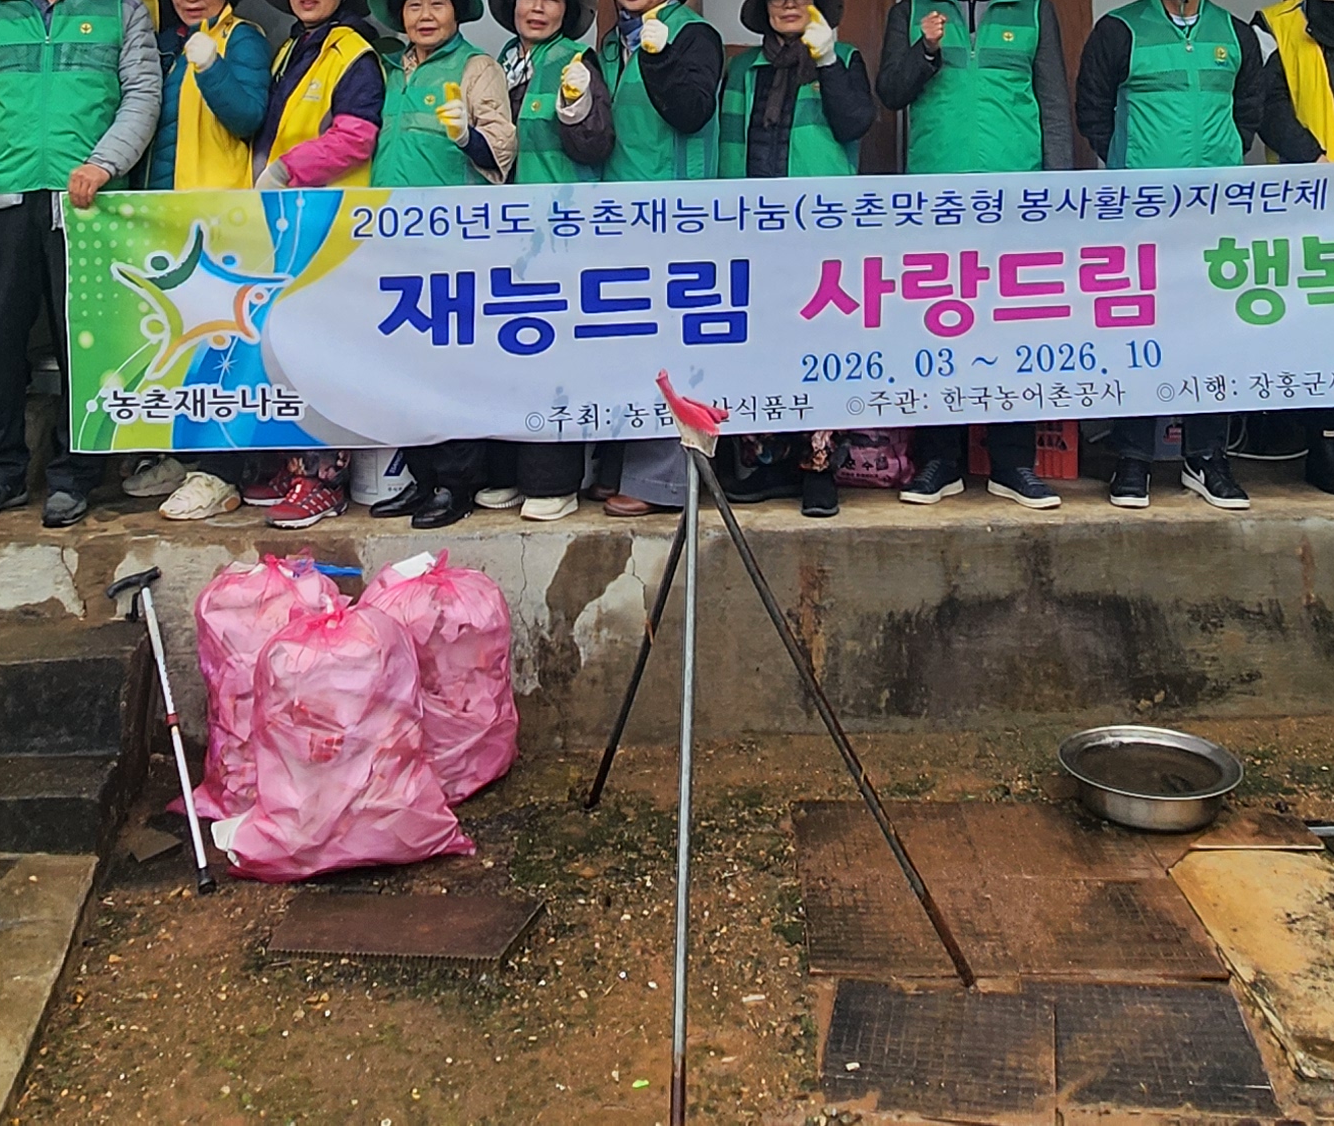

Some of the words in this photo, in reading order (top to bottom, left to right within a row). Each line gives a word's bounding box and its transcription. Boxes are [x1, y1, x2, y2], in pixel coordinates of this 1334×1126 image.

[352, 202, 536, 240] 2026년도
[1017, 177, 1328, 222] 봉사활동)지역단체
[377, 258, 752, 357] 재능드림
[799, 242, 1157, 338] 사랑드림
[1124, 339, 1162, 369] 10
[107, 387, 304, 420] 농촌재능나눔
[623, 393, 814, 429] 농림산식품부
[940, 378, 1126, 413] 한국농어촌공사
